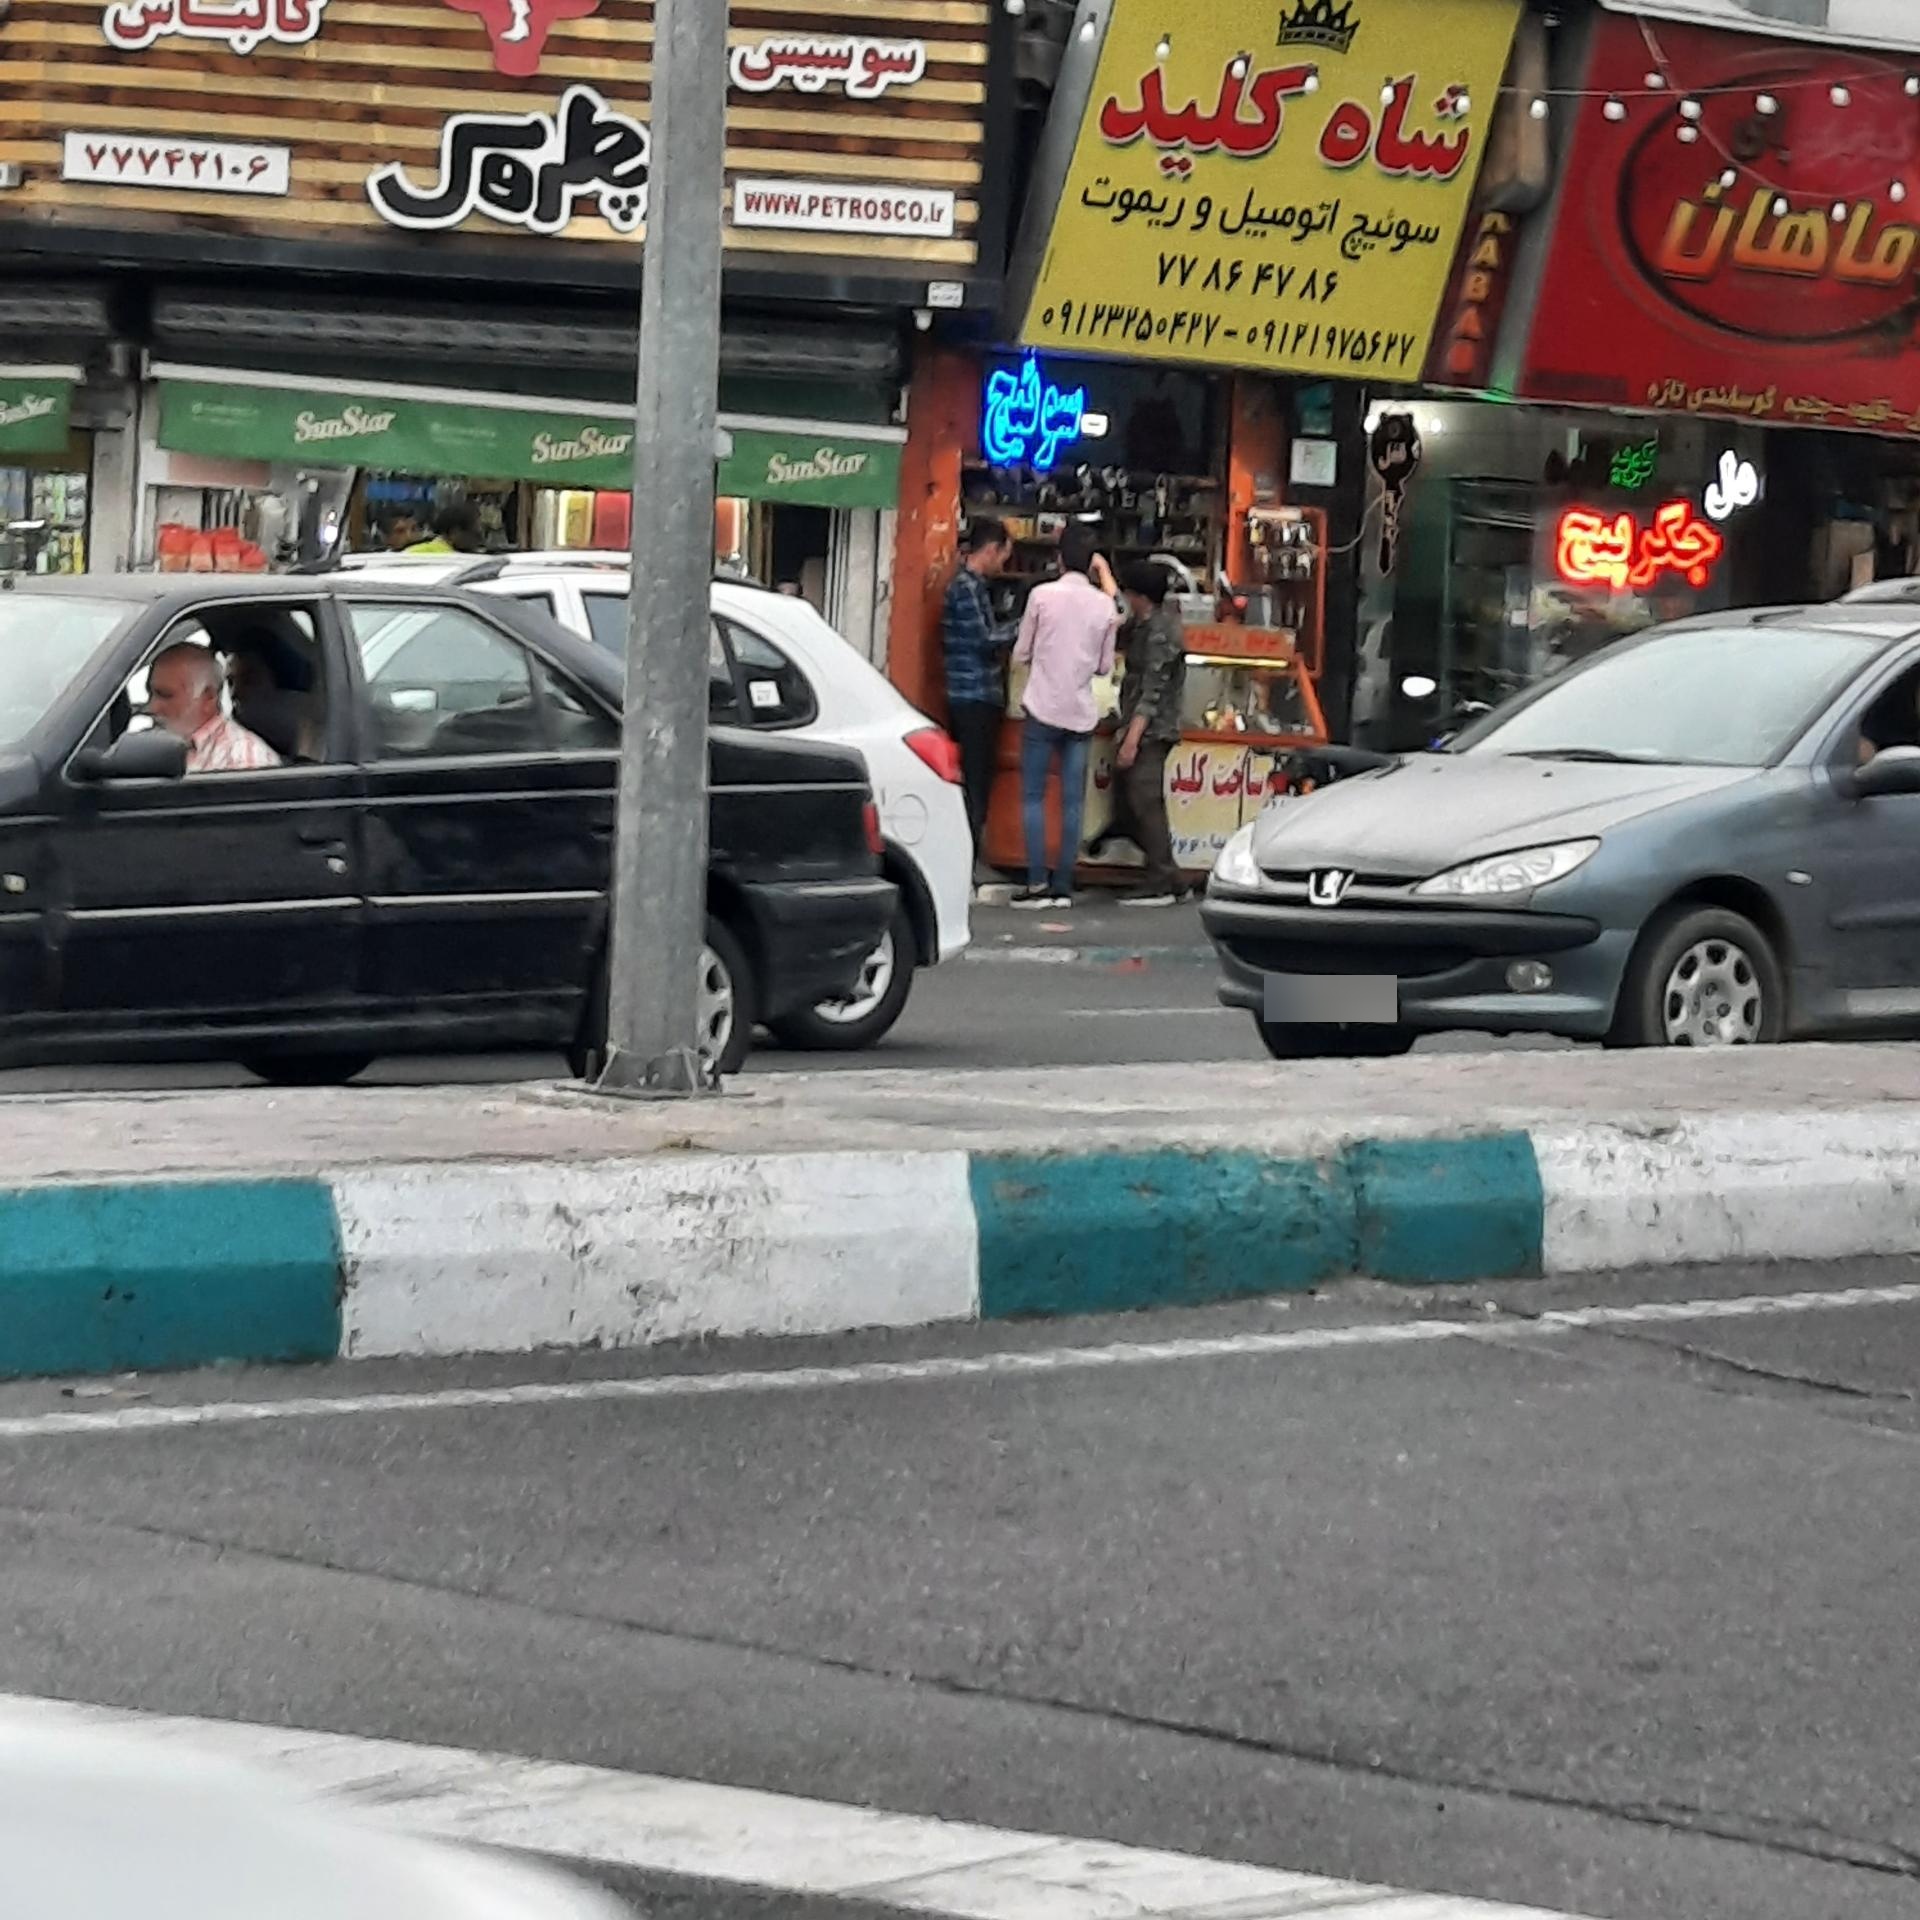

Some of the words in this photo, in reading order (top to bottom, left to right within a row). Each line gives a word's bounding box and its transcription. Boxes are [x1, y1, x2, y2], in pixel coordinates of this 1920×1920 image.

[1099, 51, 1316, 173] کلید
[1317, 74, 1471, 178] شاه
[84, 143, 270, 182] ۷۷۷۴۲۱۰۶
[1081, 177, 1185, 228] ریموت
[1190, 196, 1212, 231] و
[1218, 186, 1340, 242] اتومبیل
[1340, 206, 1440, 260] سوئیچ
[1661, 181, 1918, 285] ماهان
[295, 406, 397, 444] SunStar
[531, 426, 634, 464] SunStar
[766, 447, 870, 484] SunStar
